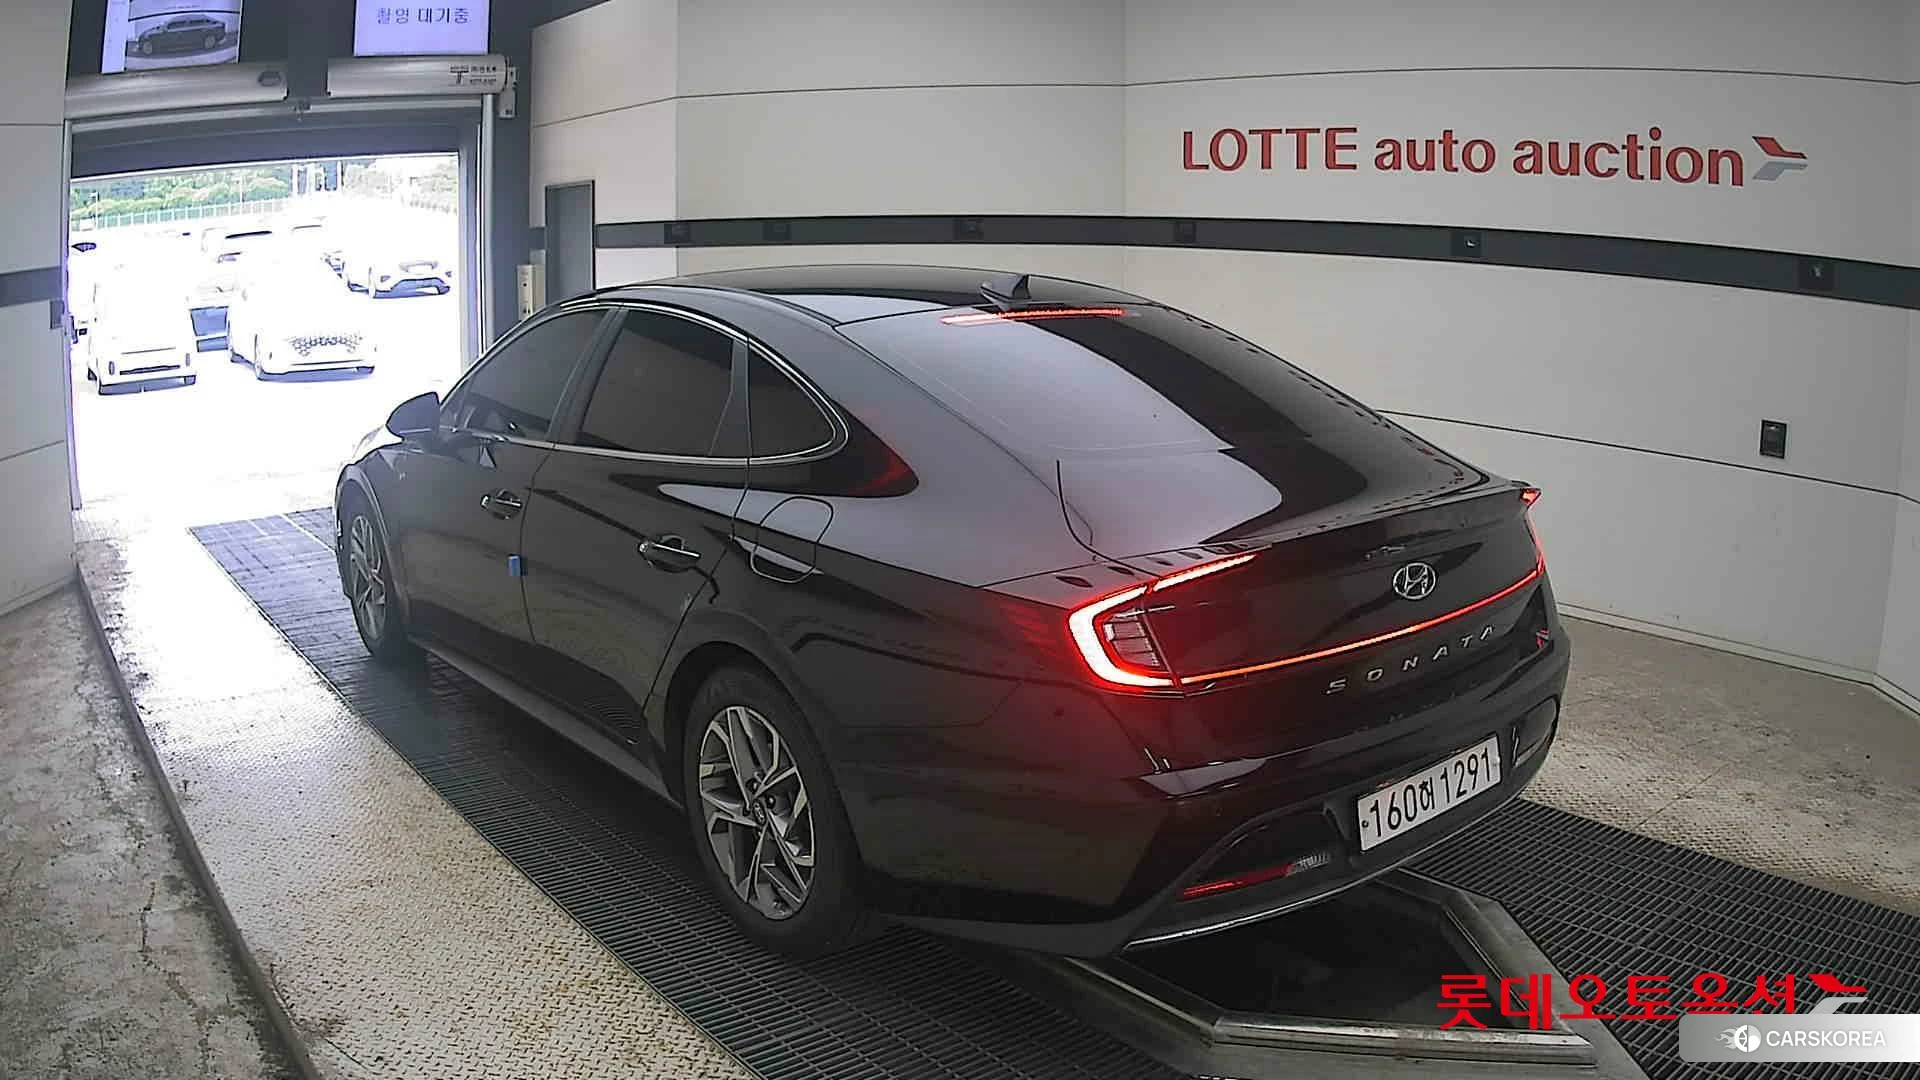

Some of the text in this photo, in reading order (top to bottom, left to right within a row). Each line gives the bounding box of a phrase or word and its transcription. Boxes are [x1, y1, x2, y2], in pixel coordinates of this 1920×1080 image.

[418, 8, 469, 24] 대기중
[1183, 127, 1744, 187] LOTTE auto auction
[1326, 624, 1495, 695] SONATA
